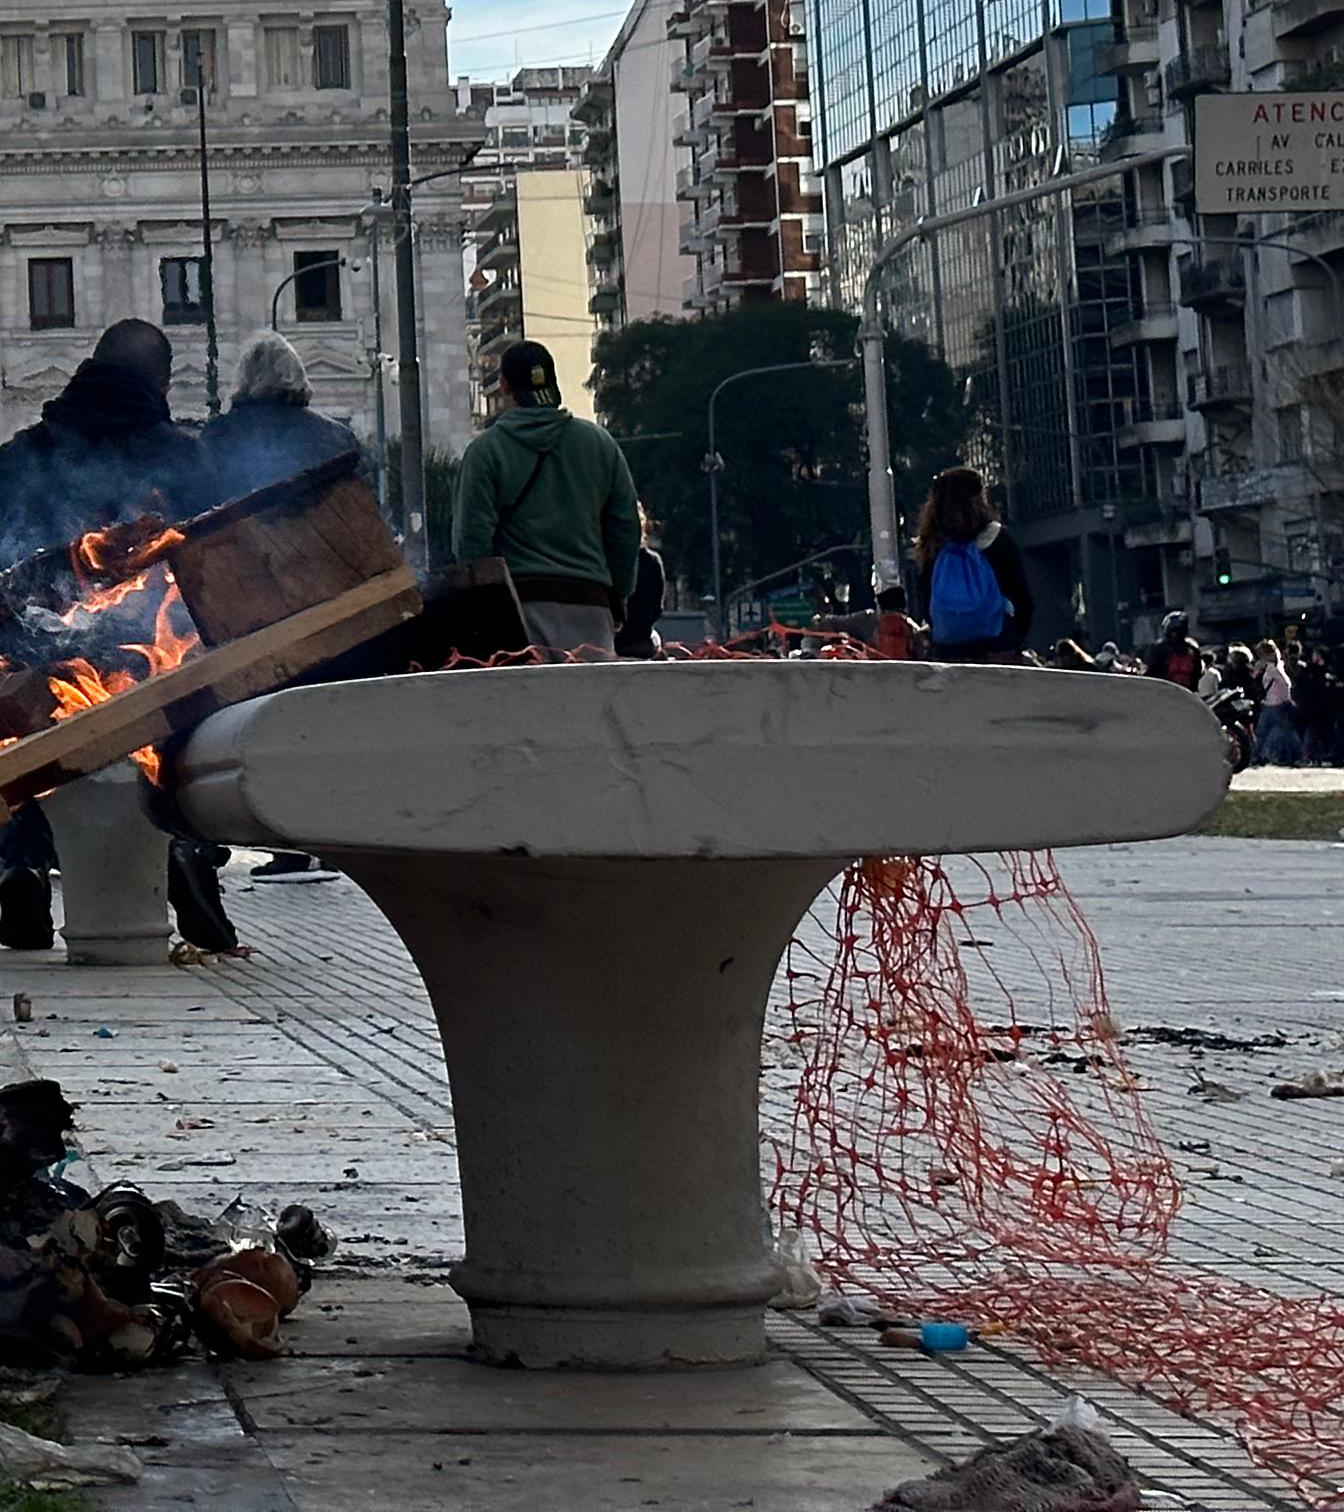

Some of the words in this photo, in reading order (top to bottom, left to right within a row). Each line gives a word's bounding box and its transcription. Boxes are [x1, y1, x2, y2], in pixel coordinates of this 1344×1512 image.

[1253, 102, 1344, 123] ATENC
[1315, 132, 1344, 148] CAL
[1215, 159, 1294, 176] CARRILES
[1331, 158, 1344, 173] E
[1226, 185, 1331, 202] TRANSPORTE
